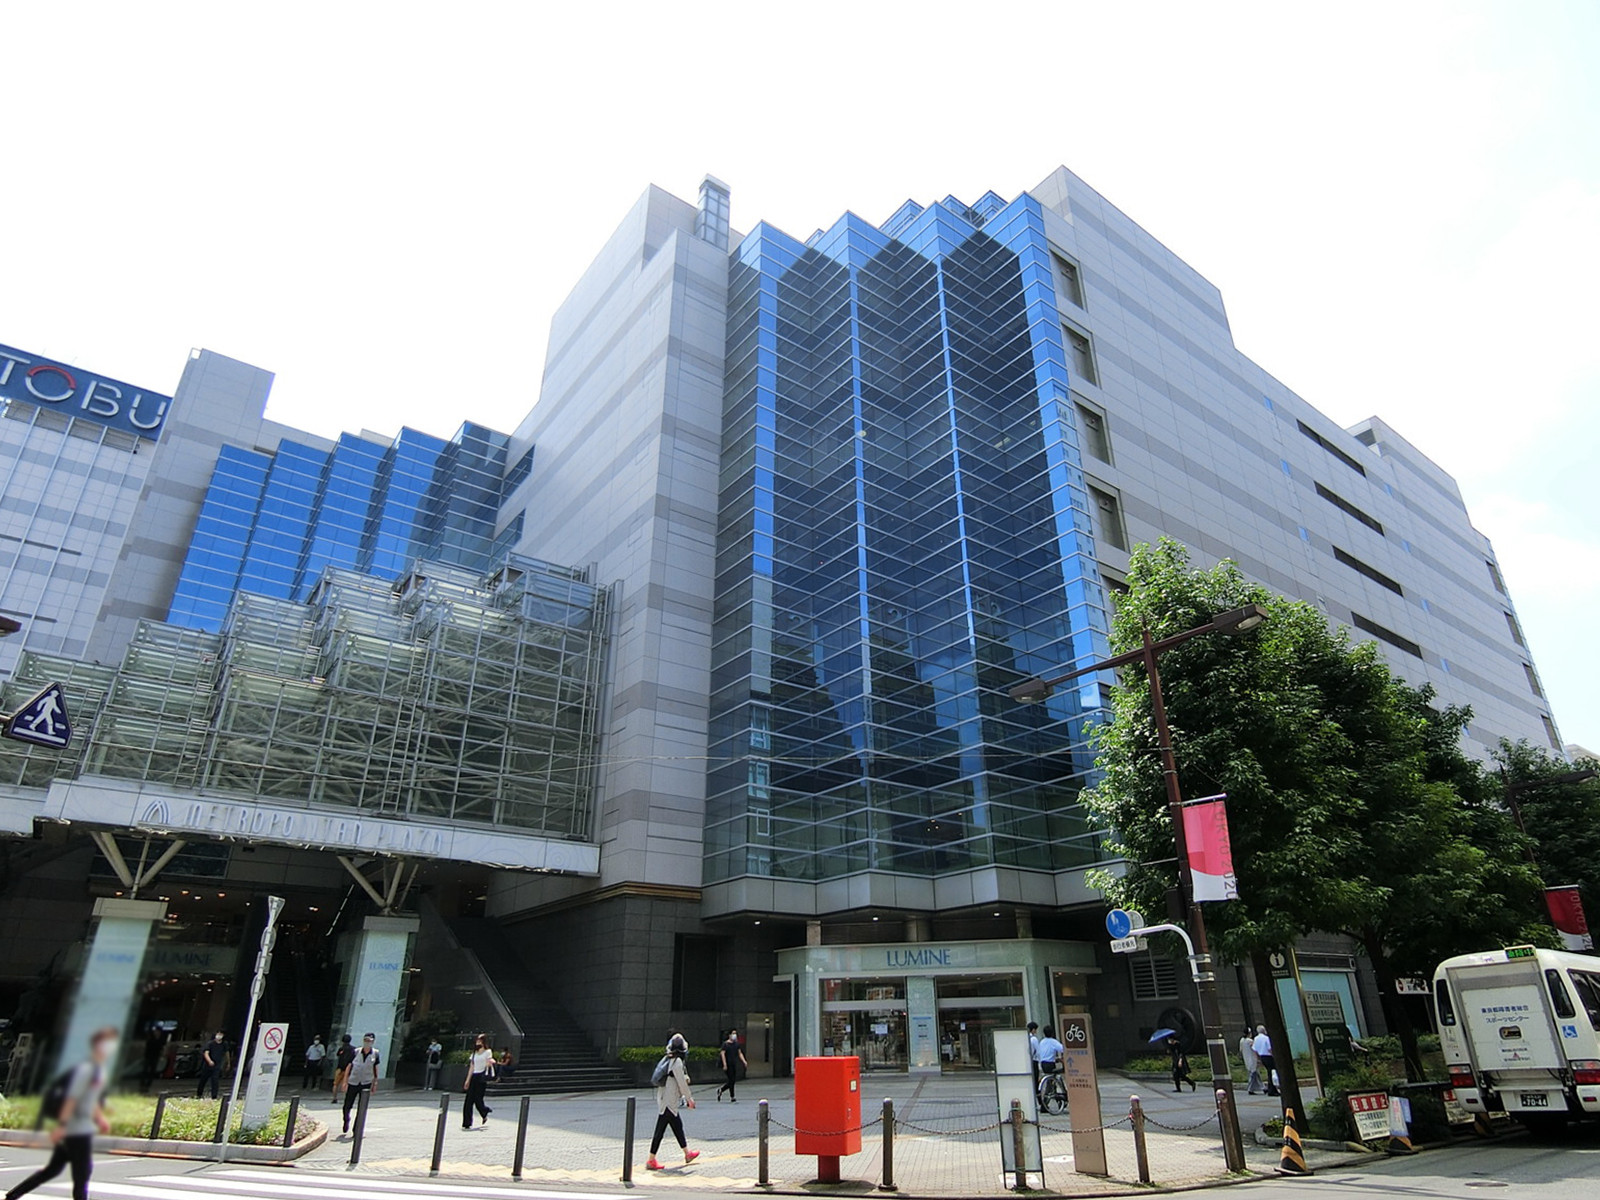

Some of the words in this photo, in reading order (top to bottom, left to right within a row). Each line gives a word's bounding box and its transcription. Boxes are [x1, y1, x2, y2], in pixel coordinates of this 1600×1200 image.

[0, 352, 167, 429] TOBU
[183, 803, 362, 844] METROPOLITAN
[378, 823, 442, 854] PLAZA
[155, 951, 213, 967] LUMINE
[886, 948, 951, 967] LUMINE
[369, 962, 399, 971] LUMINE
[1486, 1015, 1530, 1024] スポーツセンター
